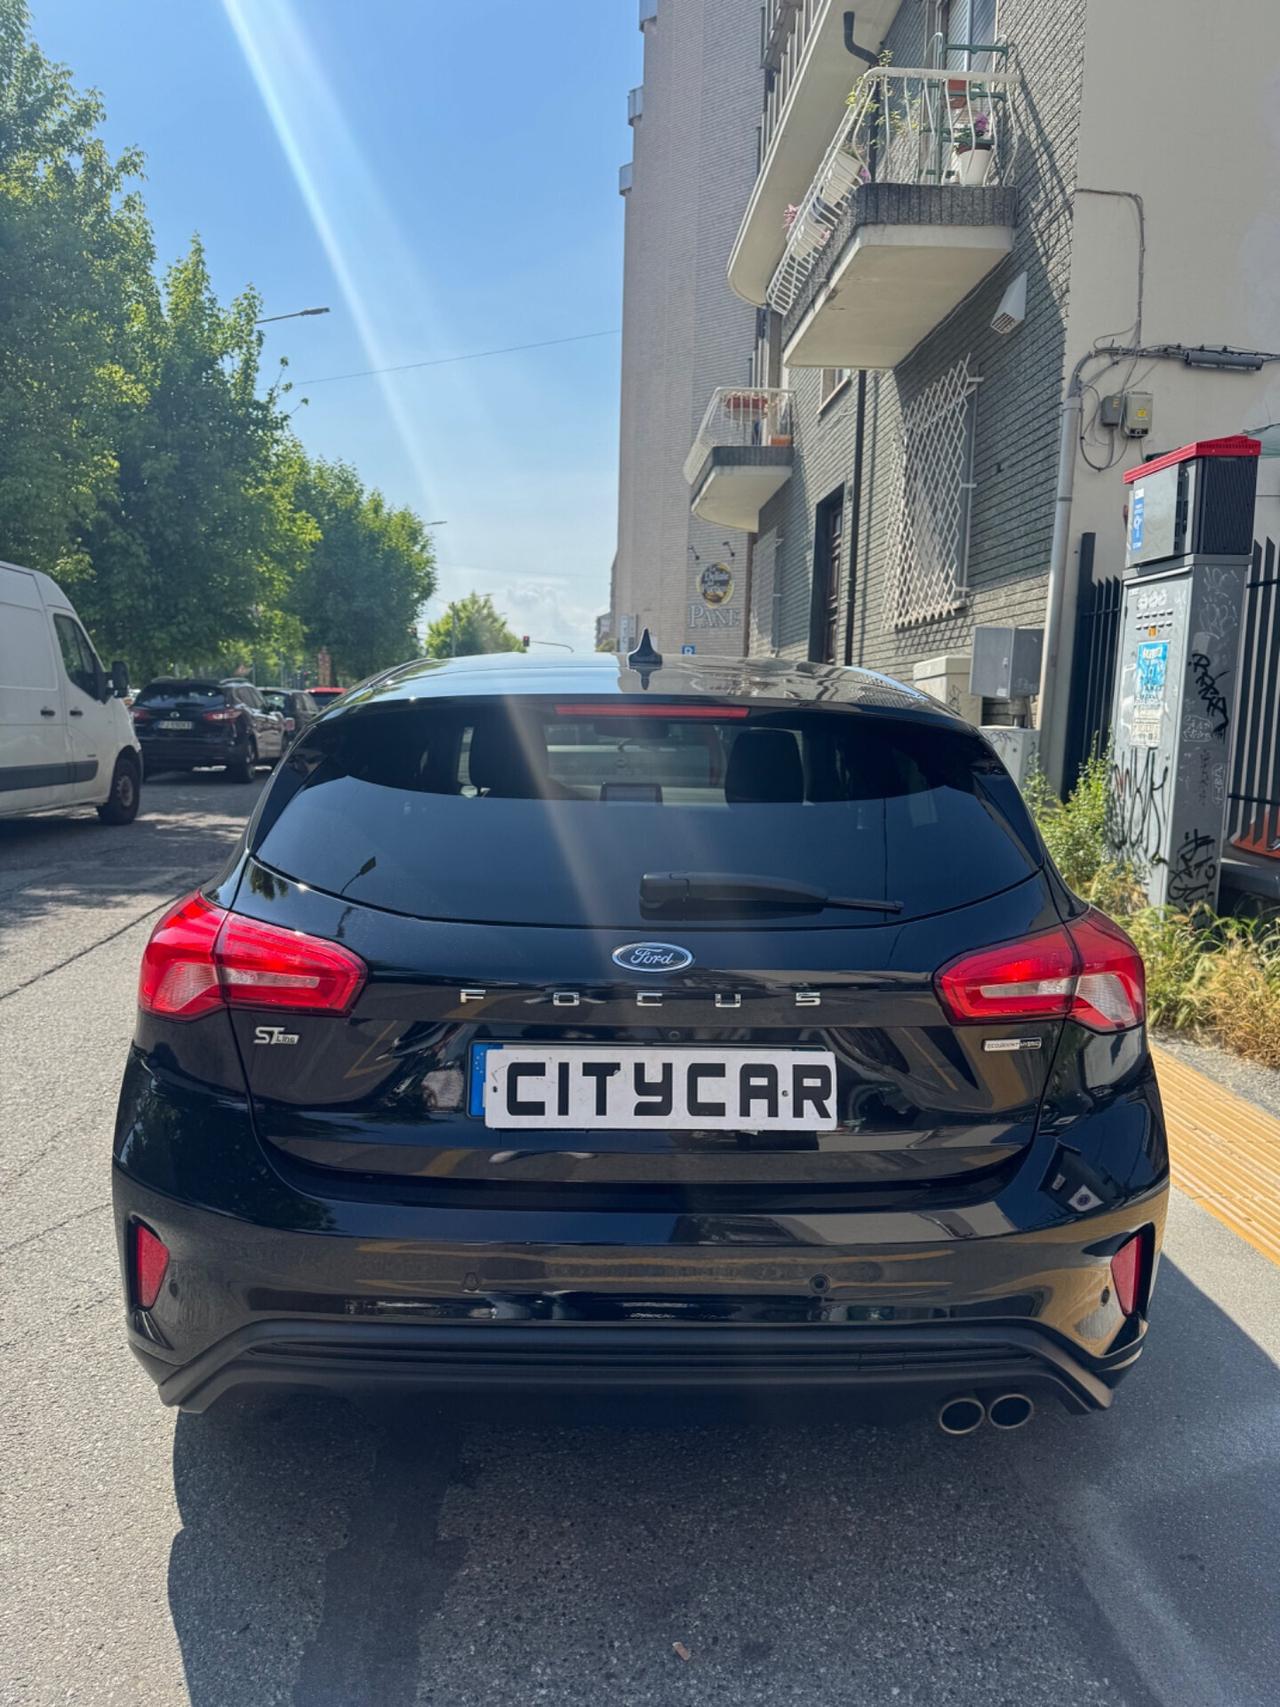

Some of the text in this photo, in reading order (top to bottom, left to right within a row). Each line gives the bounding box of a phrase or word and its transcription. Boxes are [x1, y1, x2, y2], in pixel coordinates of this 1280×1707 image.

[690, 605, 739, 627] PANE
[630, 947, 676, 966] Ford
[460, 988, 821, 1008] FOCUS
[506, 1061, 832, 1118] CITYCAR
